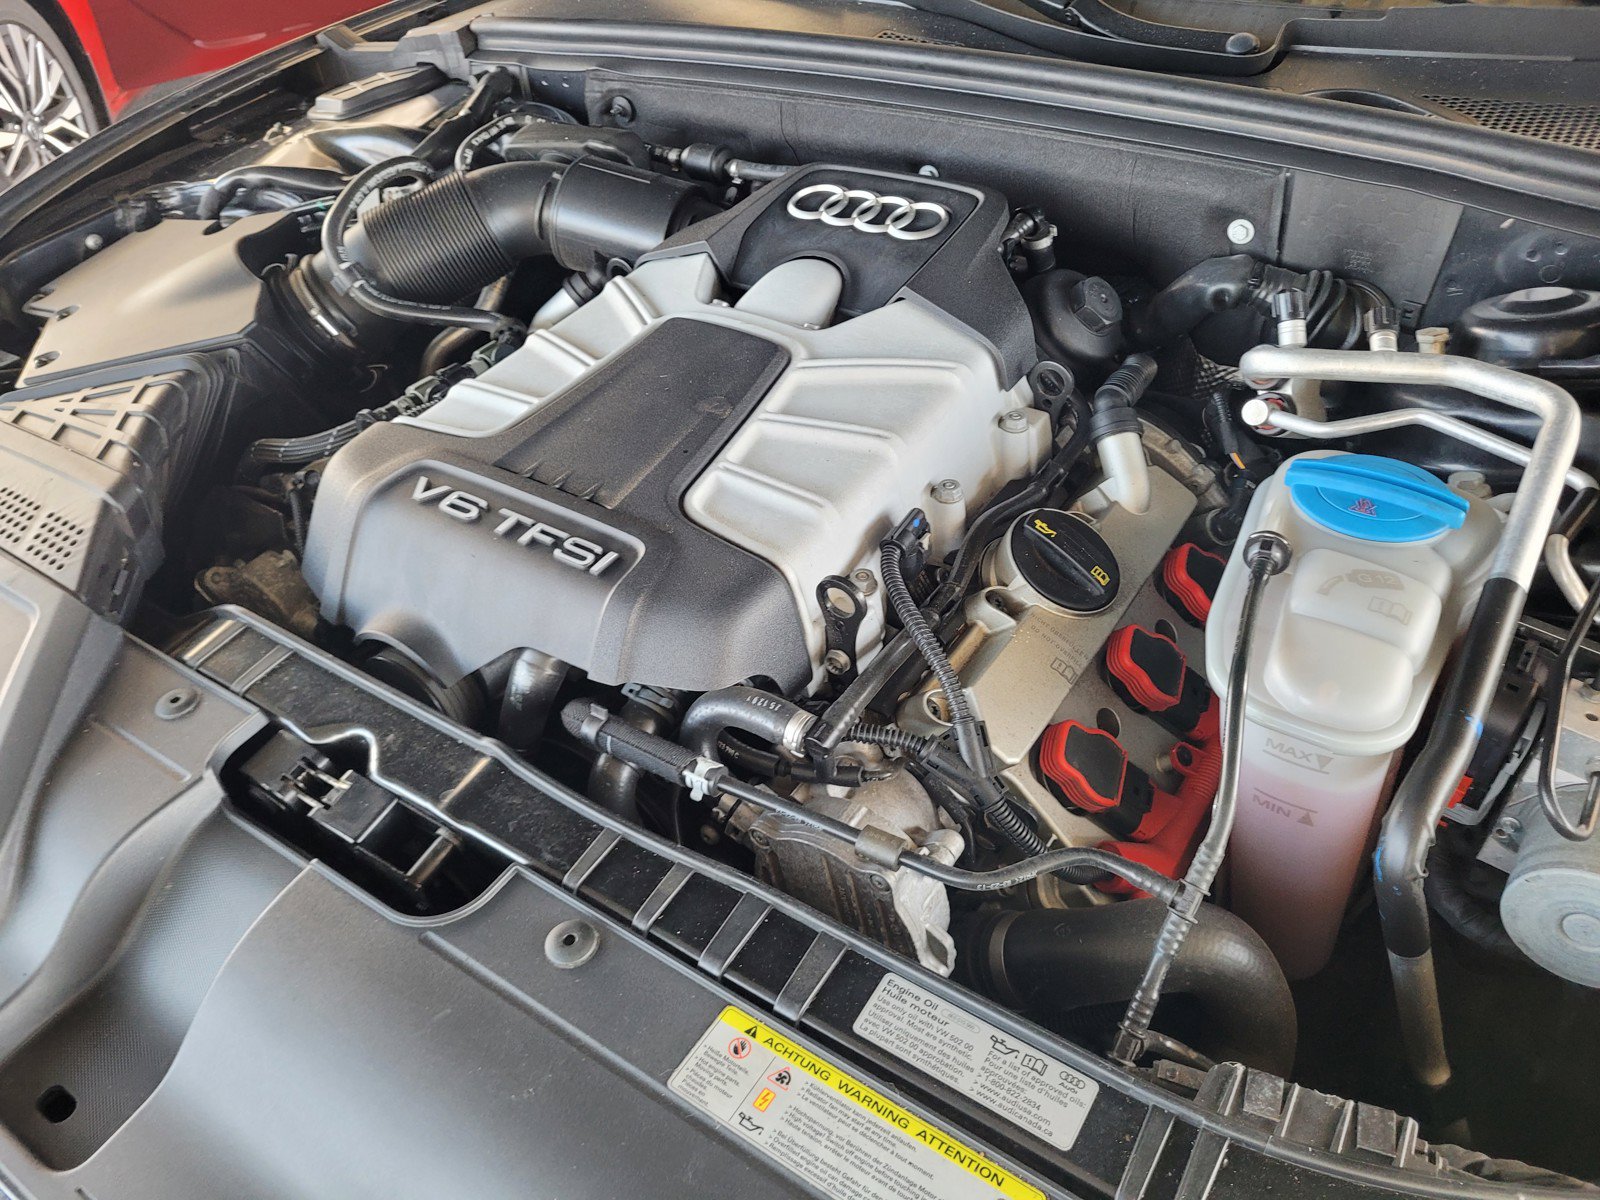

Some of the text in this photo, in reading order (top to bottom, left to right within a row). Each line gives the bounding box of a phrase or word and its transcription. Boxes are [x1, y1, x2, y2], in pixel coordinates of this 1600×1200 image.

[411, 476, 620, 577] V6 TFSI
[1265, 737, 1313, 763] MAX
[1252, 794, 1292, 819] MIN
[877, 995, 973, 1050] Use only oil with VW 502 00
[882, 986, 908, 1004] Huile
[910, 1002, 949, 1026] moteur
[886, 979, 938, 1010] Engine Oil
[864, 1018, 965, 1078] avec VW 502 00 approbation.
[868, 1010, 974, 1072] Utilisez uniquement des huiles
[868, 1028, 894, 1046] plupart
[895, 1043, 911, 1055] sont
[911, 1052, 960, 1084] synthétiques.
[872, 1002, 973, 1061] approval. Most are synthetic.
[707, 1064, 725, 1076] engine
[980, 1065, 1027, 1094] approuvées:
[984, 1057, 1068, 1107] Pour une liste d'huiles
[984, 1075, 1040, 1110] 1-800-822-2834
[988, 1050, 1000, 1060] For
[1008, 1062, 1020, 1071] list
[1021, 1068, 1030, 1076] of
[1030, 1074, 1067, 1098] approved
[1069, 1095, 1086, 1108] oils:
[763, 1036, 1006, 1186] ACHTUNG WARNING ATTENTION
[805, 1088, 828, 1104] Radiator
[838, 1110, 850, 1118] may
[851, 1117, 864, 1126] start
[870, 1129, 882, 1139] any
[975, 1089, 1053, 1136] www.audicanada.ca
[979, 1082, 1050, 1125] www.audiusa.com
[772, 1136, 800, 1156] Overfilled
[799, 1155, 819, 1170] engine
[827, 1173, 838, 1181] can
[838, 1180, 863, 1198] damage
[777, 1130, 787, 1138] Bei
[819, 1158, 841, 1174] besteht
[841, 1172, 861, 1187] Gefahr
[861, 1185, 871, 1193] für
[784, 1118, 801, 1130] Haute
[849, 1160, 870, 1176] moteur
[870, 1174, 888, 1186] avant
[788, 1112, 802, 1124] High
[825, 1136, 845, 1149] Switch
[853, 1155, 873, 1169] engine
[874, 1167, 893, 1181] before
[892, 1179, 920, 1199] touching
[809, 1100, 837, 1118] ventilateur
[894, 1153, 907, 1162] tout
[907, 1160, 935, 1179] moment.
[844, 1139, 872, 1159] Berühren
[872, 1157, 882, 1165] der
[882, 1163, 918, 1188] Zündanlage
[917, 1185, 937, 1199] Motor
